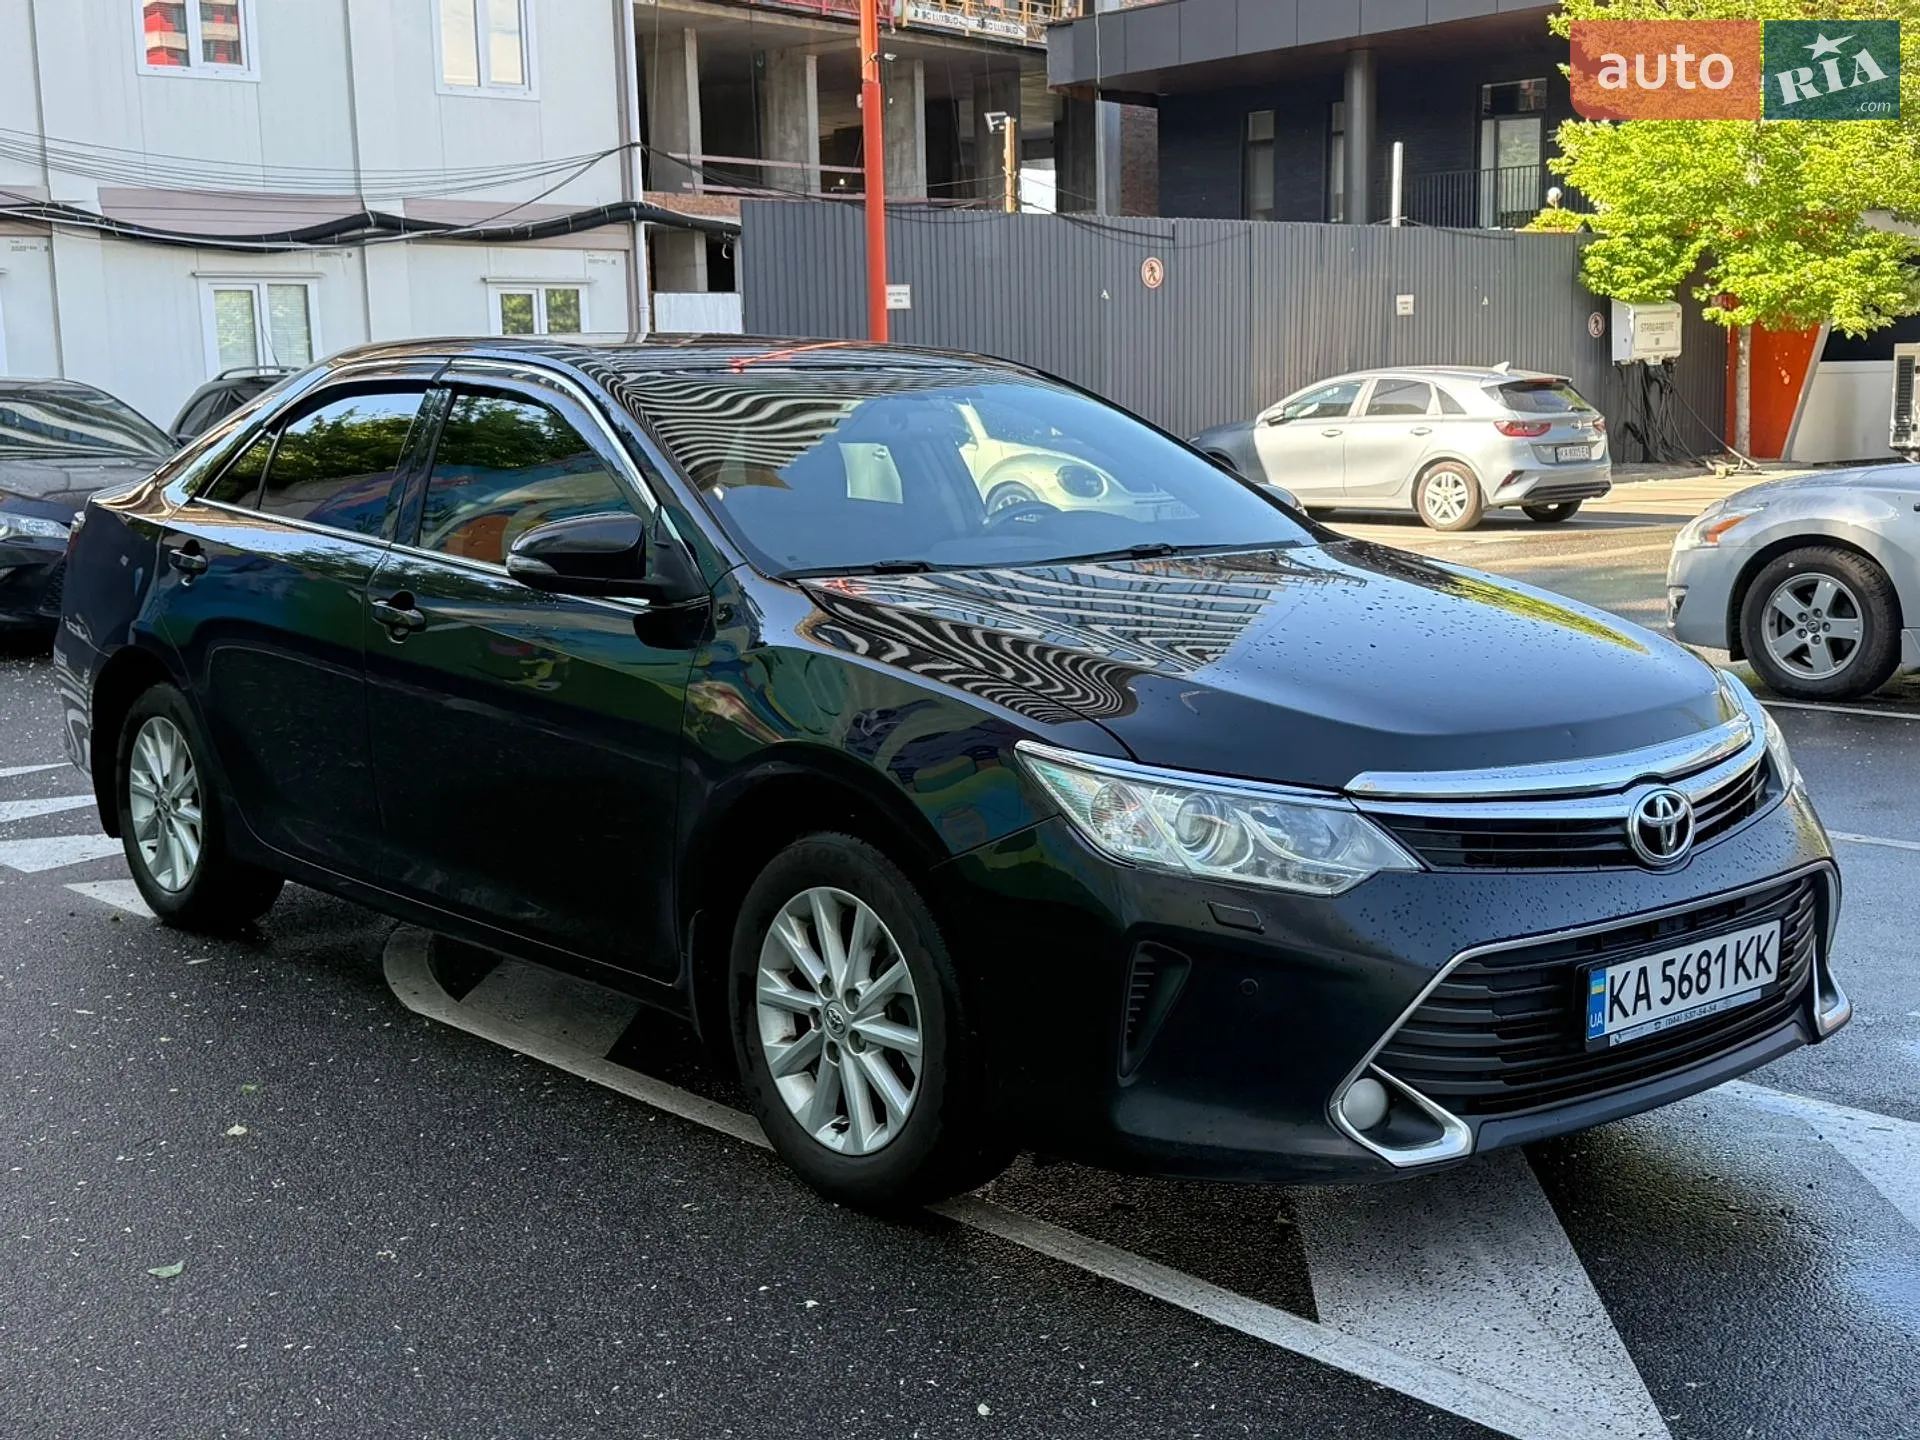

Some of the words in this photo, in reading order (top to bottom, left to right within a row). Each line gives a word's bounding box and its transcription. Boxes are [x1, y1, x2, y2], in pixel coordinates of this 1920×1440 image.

[1608, 965, 1652, 1023] KA
[1659, 944, 1728, 1006] 5681
[1733, 930, 1776, 985] KK
[1590, 1012, 1604, 1028] UA
